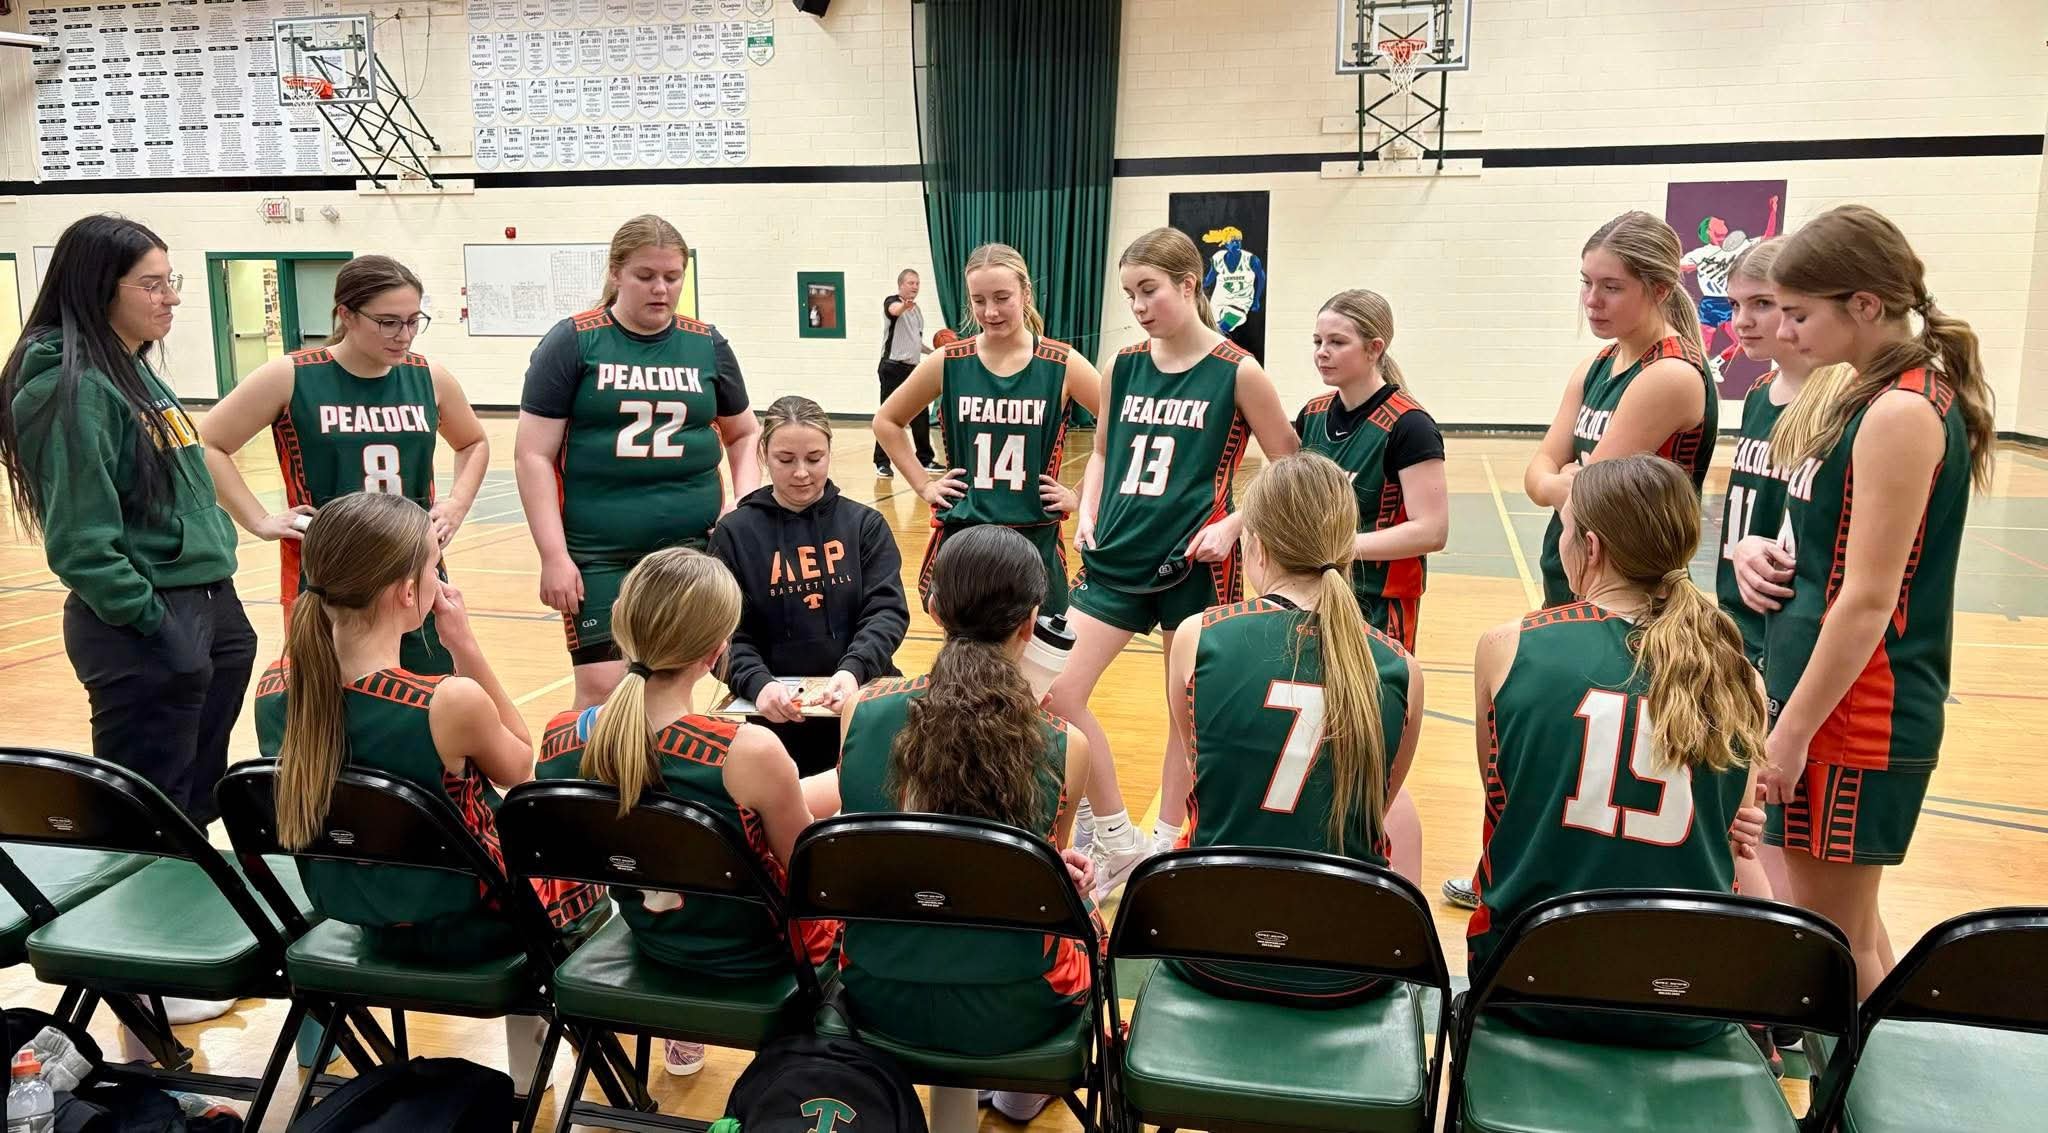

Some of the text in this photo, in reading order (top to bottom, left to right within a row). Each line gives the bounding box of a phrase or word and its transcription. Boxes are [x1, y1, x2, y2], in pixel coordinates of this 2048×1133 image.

[267, 203, 281, 216] EXIT
[596, 363, 704, 394] PEACOCK
[319, 405, 431, 434] PEACOCK
[615, 400, 688, 458] 22
[958, 396, 1048, 425] PEACOCK
[1119, 394, 1210, 430] PEACOCK
[362, 443, 403, 495] 8
[972, 431, 1027, 492] 14
[1118, 433, 1176, 497] 13
[1722, 484, 1758, 562] 11
[770, 539, 845, 585] AEP
[1261, 680, 1326, 814] 7
[1562, 688, 1695, 847] 15
